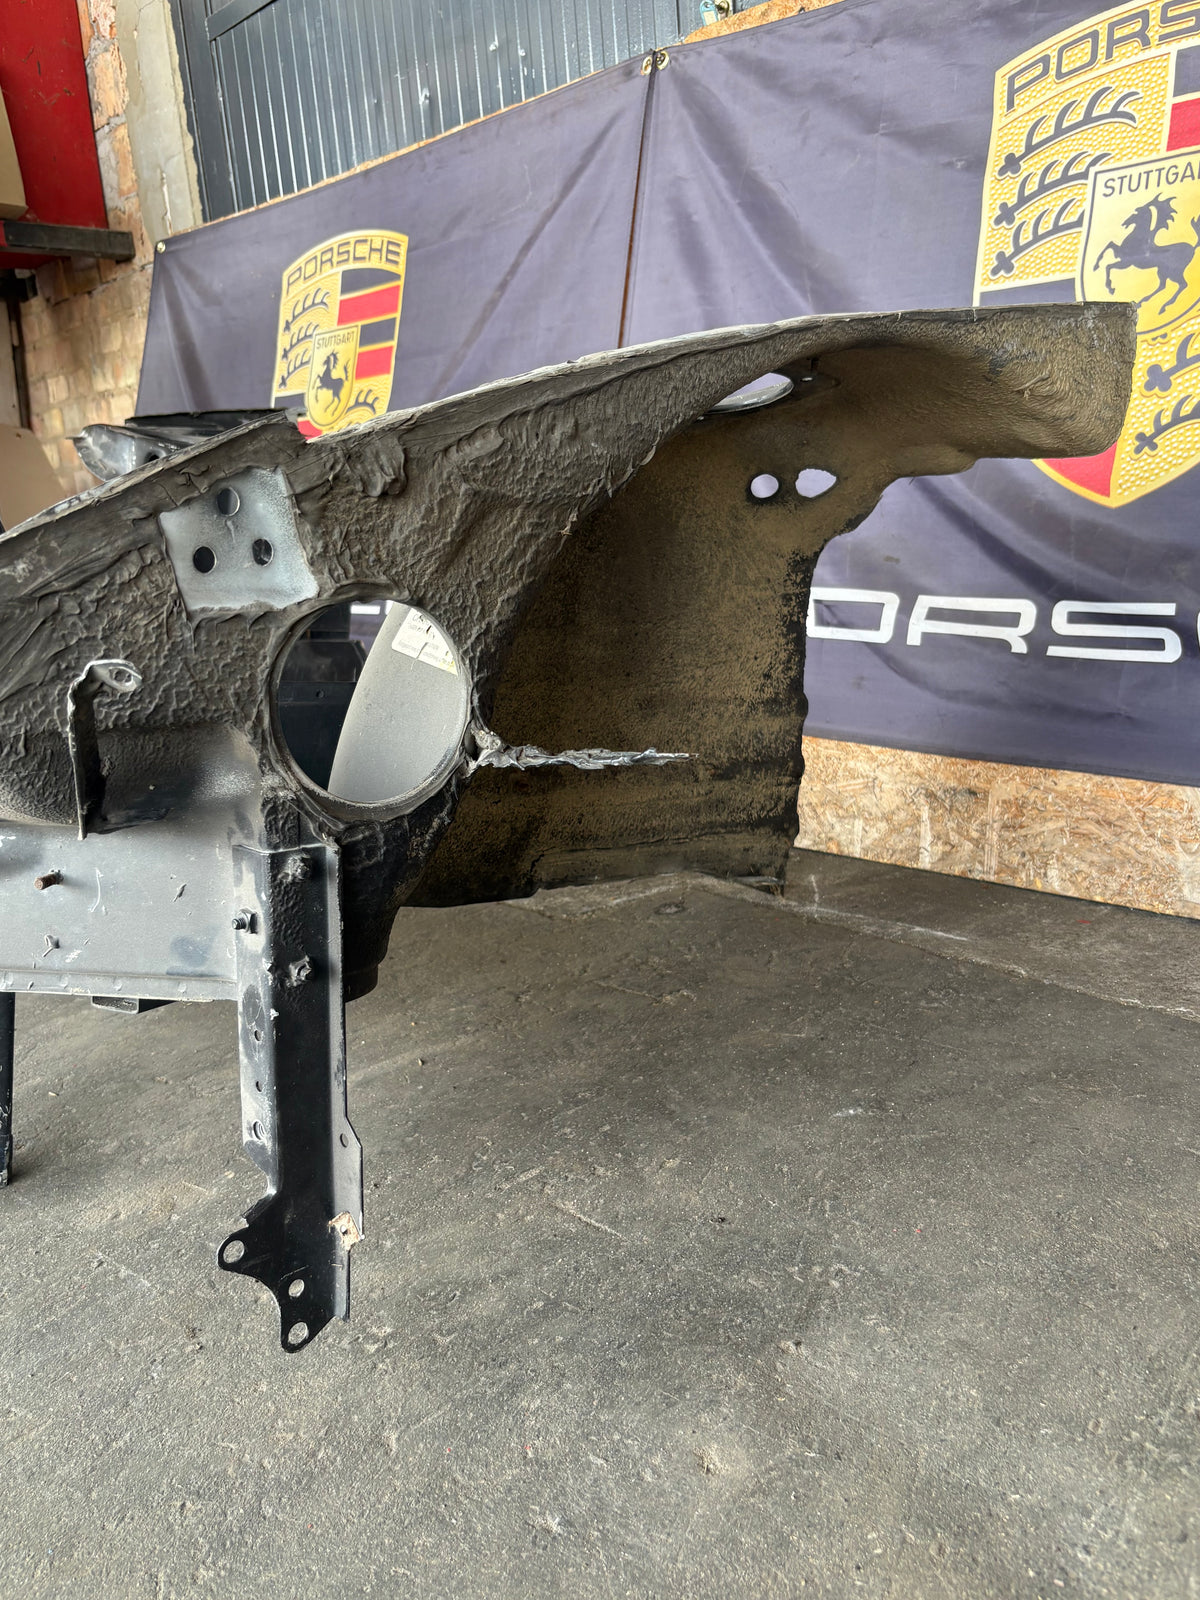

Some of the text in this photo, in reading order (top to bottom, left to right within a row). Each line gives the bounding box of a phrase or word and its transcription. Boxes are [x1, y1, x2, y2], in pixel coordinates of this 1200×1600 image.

[1005, 0, 1200, 112] PORS
[1102, 160, 1200, 198] STUTTGA
[286, 238, 401, 296] PORSCHE
[316, 330, 355, 350] STUTTGART
[805, 586, 1200, 664] ORS
